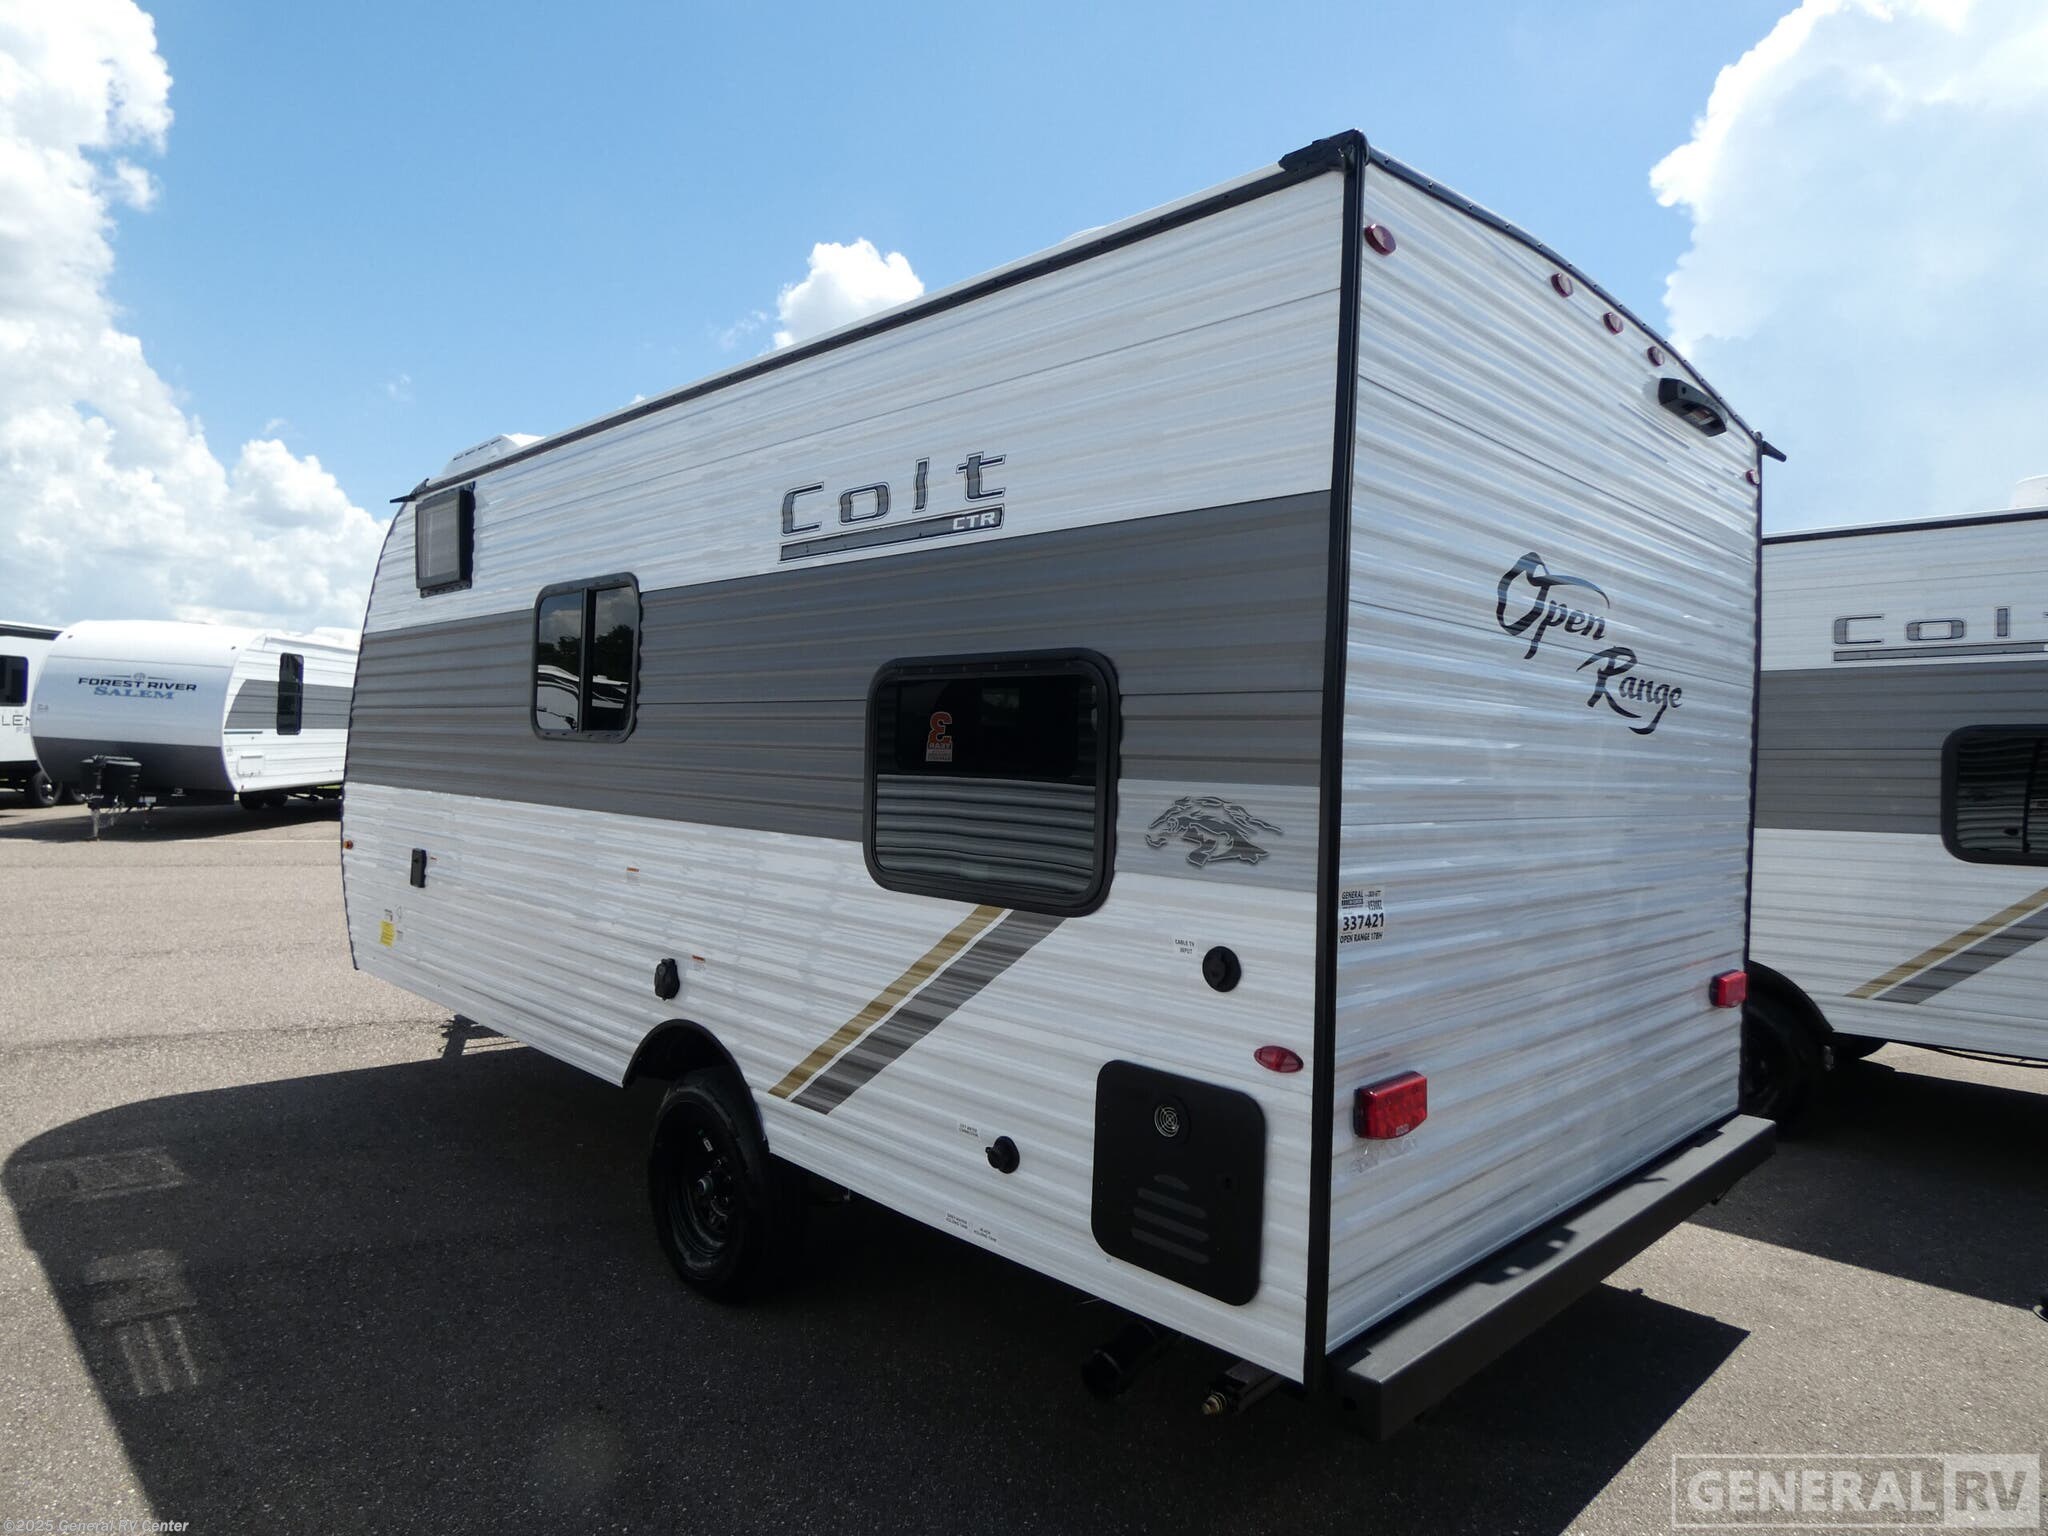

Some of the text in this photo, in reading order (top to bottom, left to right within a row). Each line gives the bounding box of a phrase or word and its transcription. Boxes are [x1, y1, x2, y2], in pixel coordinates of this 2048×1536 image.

[953, 511, 995, 530] CTR
[1496, 552, 1610, 660] Open
[78, 677, 198, 691] FOREST RIVER
[93, 686, 174, 699] SALEM
[1576, 646, 1683, 735] Range
[1342, 912, 1385, 931] 337421
